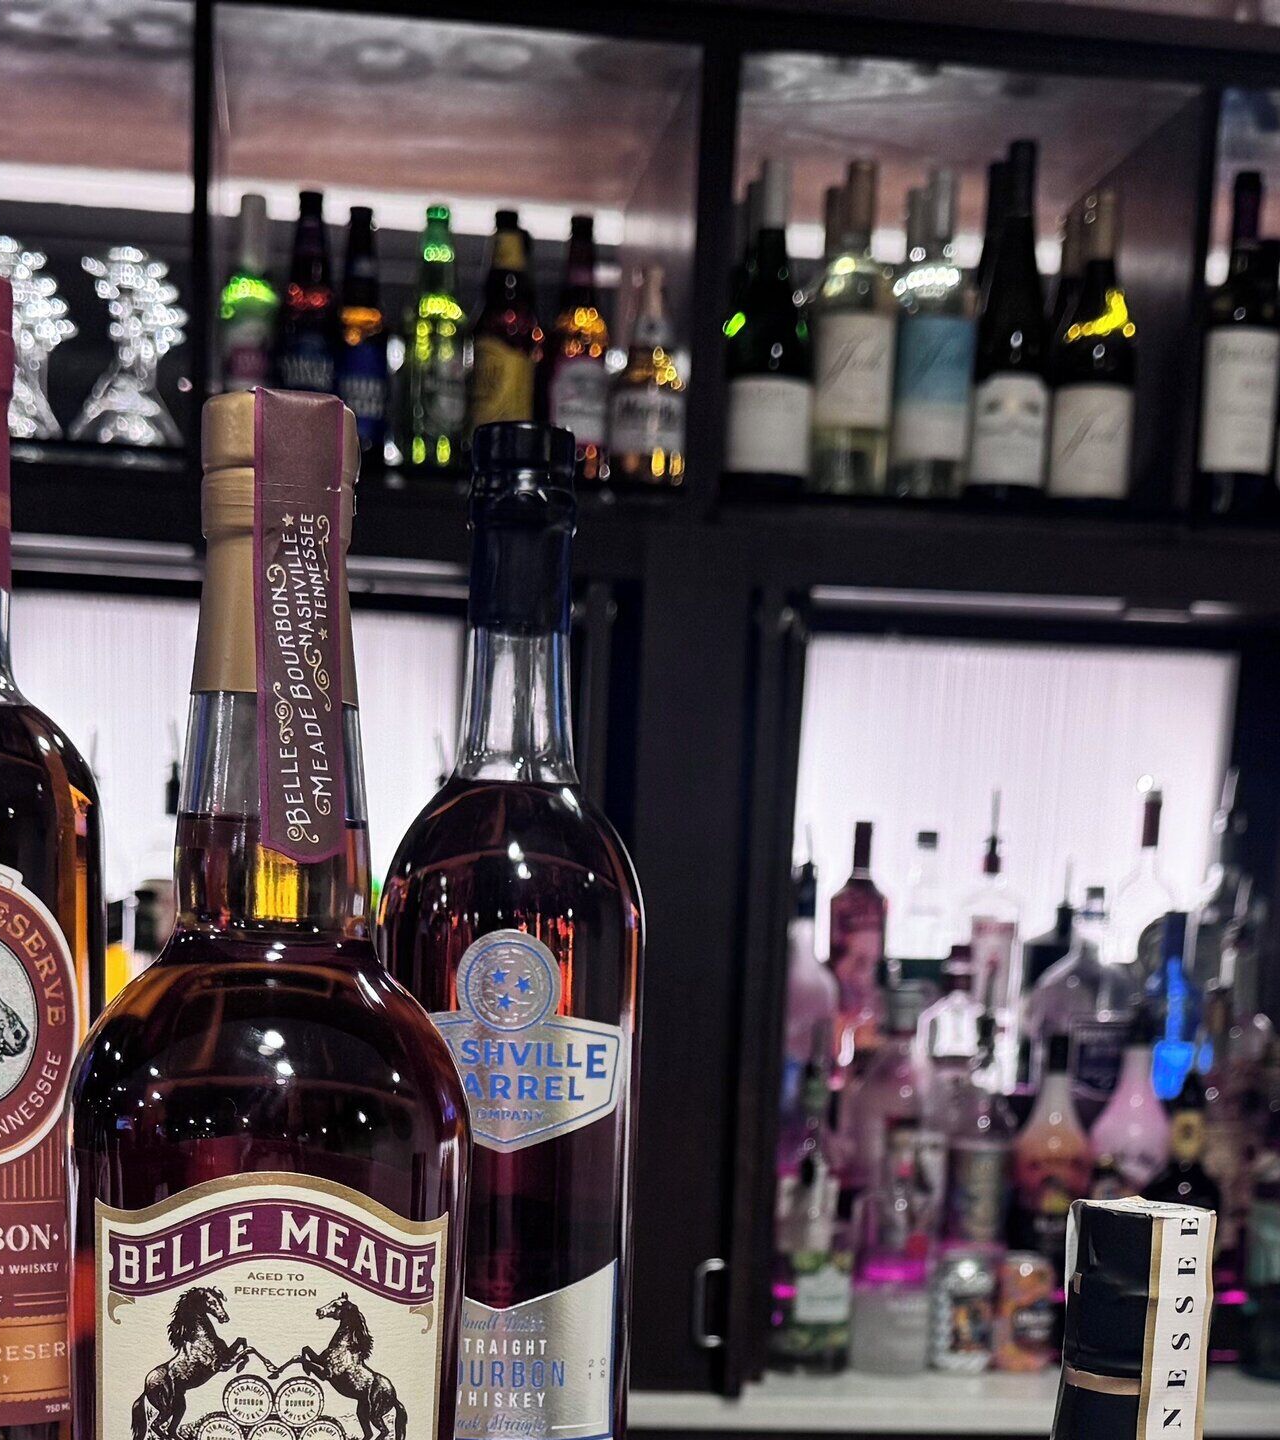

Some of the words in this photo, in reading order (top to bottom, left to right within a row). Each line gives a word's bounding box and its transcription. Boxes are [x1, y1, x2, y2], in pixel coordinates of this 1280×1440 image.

[301, 512, 328, 619] TENNESSEE
[282, 533, 313, 647] NASHVILLE
[271, 587, 313, 700] BOURBON
[299, 706, 333, 799] MEADE
[279, 746, 312, 826] BELLE
[118, 1212, 255, 1286] BELLE
[279, 1210, 428, 1295] MEADE
[8, 1261, 60, 1276] WHISKEY
[247, 1271, 283, 1282] AGED
[287, 1272, 305, 1282] TO
[233, 1286, 318, 1298] PERFECTION
[233, 1385, 265, 1397] STRAIGHT
[284, 1385, 316, 1398] STRAIGHT
[232, 1407, 265, 1420] WHISKEY
[283, 1408, 315, 1422] WHISKEY
